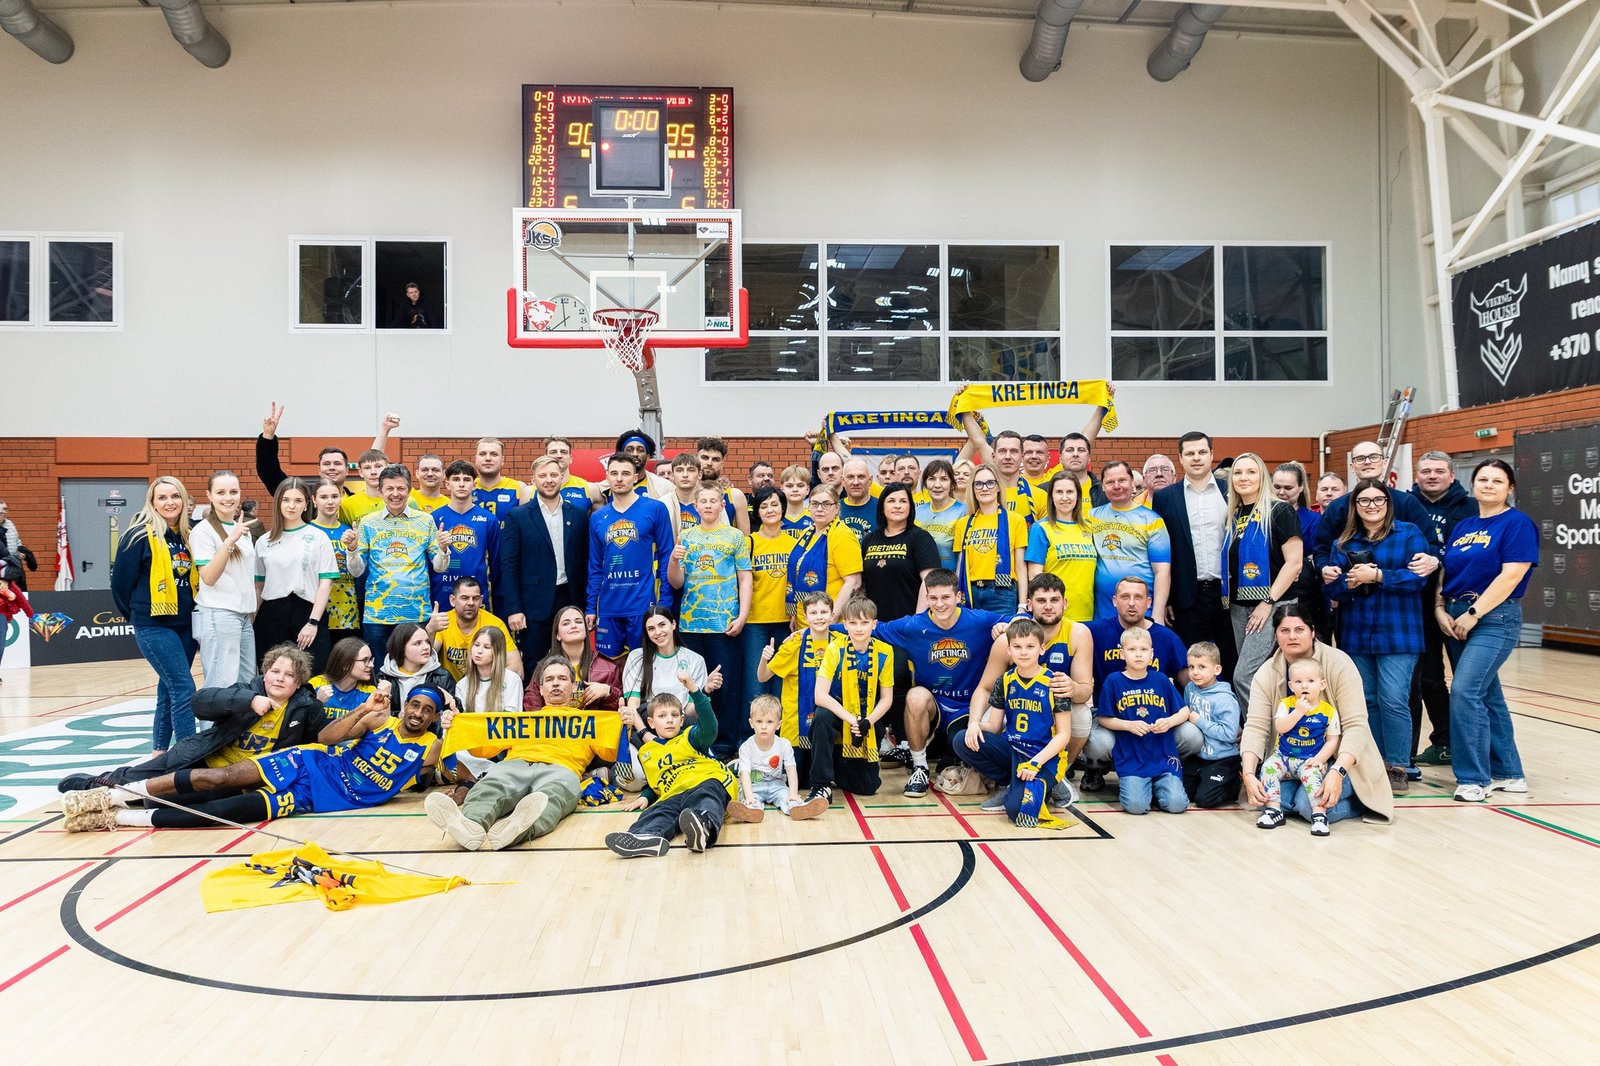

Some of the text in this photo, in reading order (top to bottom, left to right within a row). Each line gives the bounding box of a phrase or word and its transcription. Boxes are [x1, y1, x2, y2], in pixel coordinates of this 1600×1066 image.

[614, 109, 660, 131] 0:00
[666, 123, 695, 147] 95
[1549, 260, 1590, 290] Namų
[1484, 292, 1513, 308] VIKING
[1481, 302, 1518, 324] HOUSE
[713, 320, 729, 328] NKL
[1550, 332, 1590, 360] +370
[991, 381, 1079, 403] KRETINGA
[837, 411, 943, 427] KRETINGA
[606, 528, 636, 541] KRETINGA
[867, 543, 907, 553] KRETINGA
[607, 570, 640, 579] RIVILE
[92, 611, 127, 625] CASI
[931, 649, 968, 661] KRETINGA
[1008, 698, 1043, 713] KRETINGA
[486, 715, 597, 740] KRETINGA
[1015, 713, 1029, 733] 6
[268, 757, 285, 782] RIVILE
[370, 746, 402, 775] 55
[352, 756, 394, 791] KRETINGA
